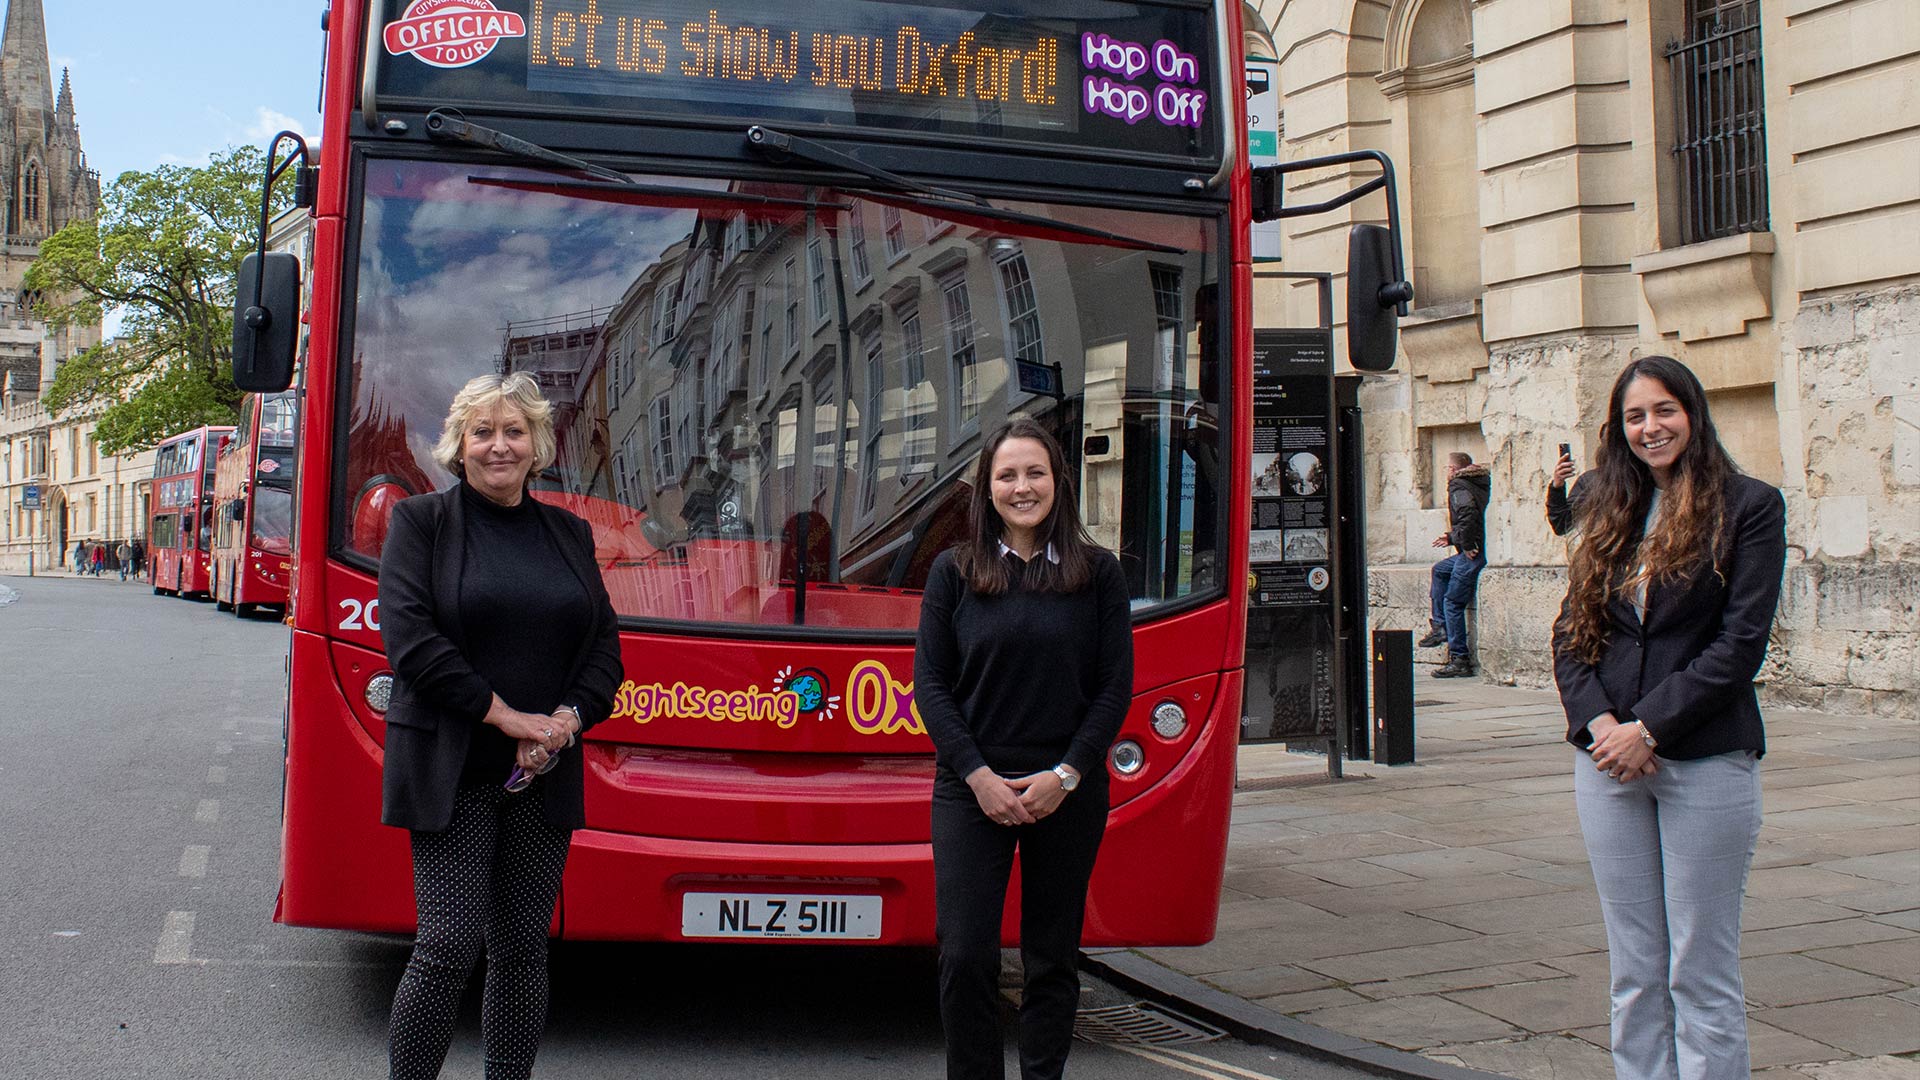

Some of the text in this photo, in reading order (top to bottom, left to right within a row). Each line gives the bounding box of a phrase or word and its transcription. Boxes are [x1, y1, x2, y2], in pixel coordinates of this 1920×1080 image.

[398, 16, 518, 48] OFFICIAL
[435, 41, 488, 62] TOUR
[532, 0, 1057, 105] Let us show you Oxford!
[1084, 34, 1197, 82] Hop On
[1086, 77, 1204, 125] Hop Off
[848, 661, 925, 733] Ox
[718, 899, 787, 933] NLZ
